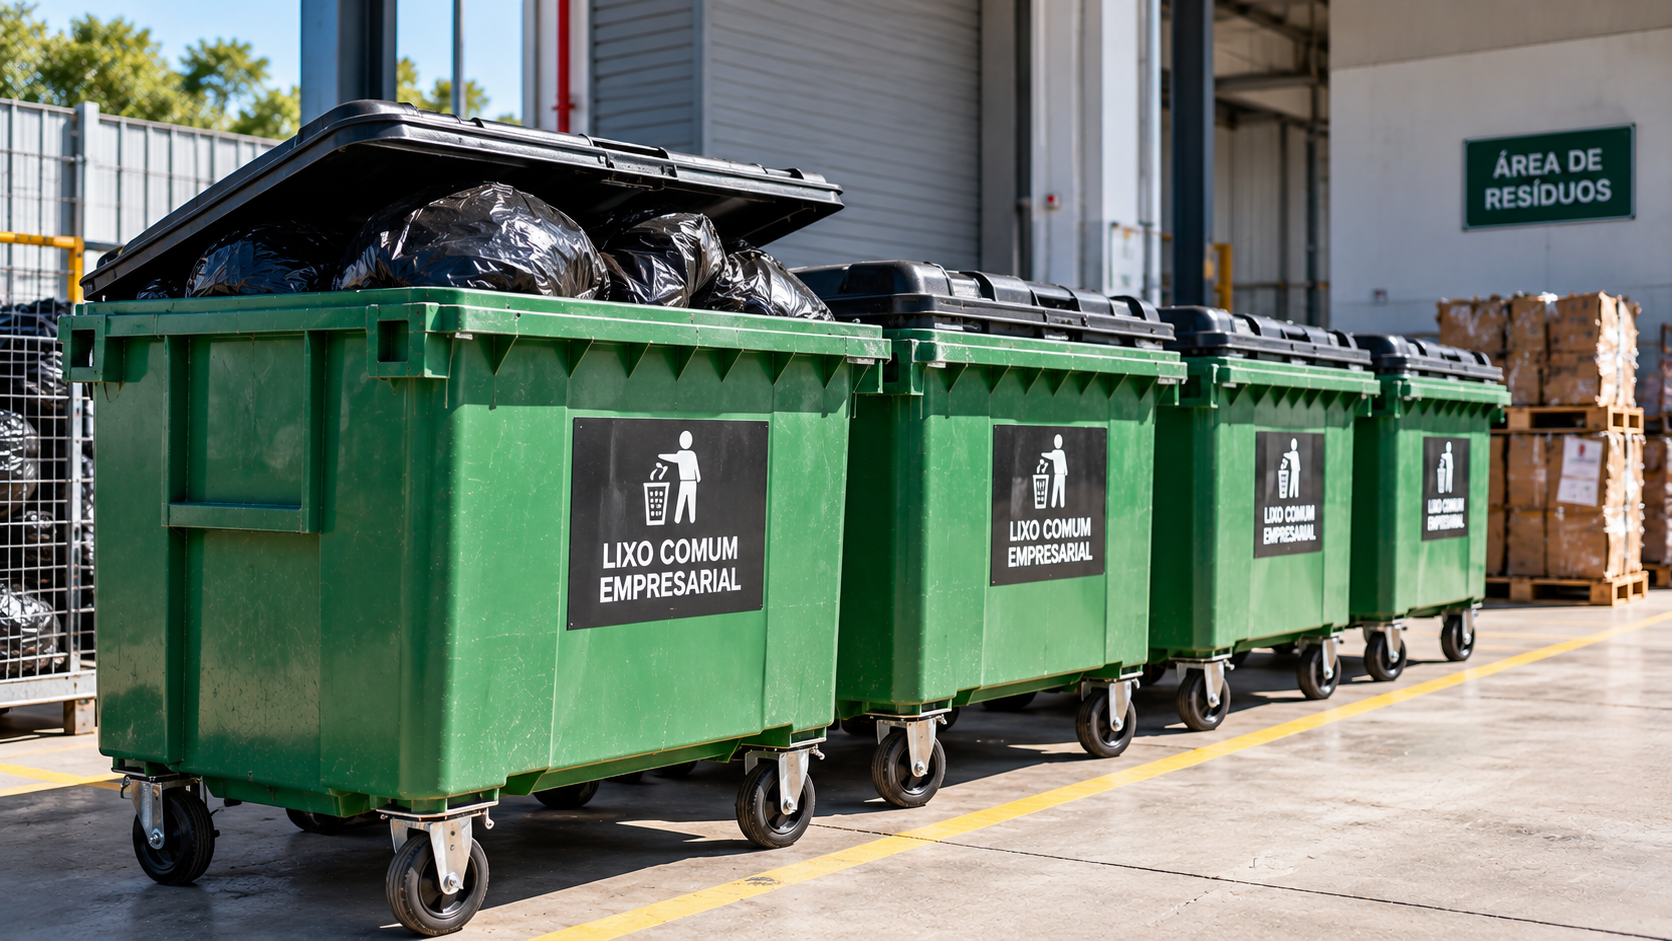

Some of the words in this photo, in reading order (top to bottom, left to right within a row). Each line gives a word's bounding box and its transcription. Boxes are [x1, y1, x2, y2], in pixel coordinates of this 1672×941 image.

[1493, 149, 1561, 178] ÁREA
[1568, 147, 1603, 173] DE
[1484, 178, 1612, 211] RESÍDUOS
[1264, 505, 1284, 524] LIXO
[1284, 504, 1315, 523] COMUM
[1009, 519, 1040, 542] LIXO
[1042, 517, 1092, 540] COMUM
[1263, 523, 1317, 545] EMPRESARIAL
[602, 540, 654, 569] LIXO
[660, 535, 738, 565] COMUM
[1007, 541, 1093, 568] EMPRESARIAL
[599, 567, 742, 603] EMPRESARIAL
